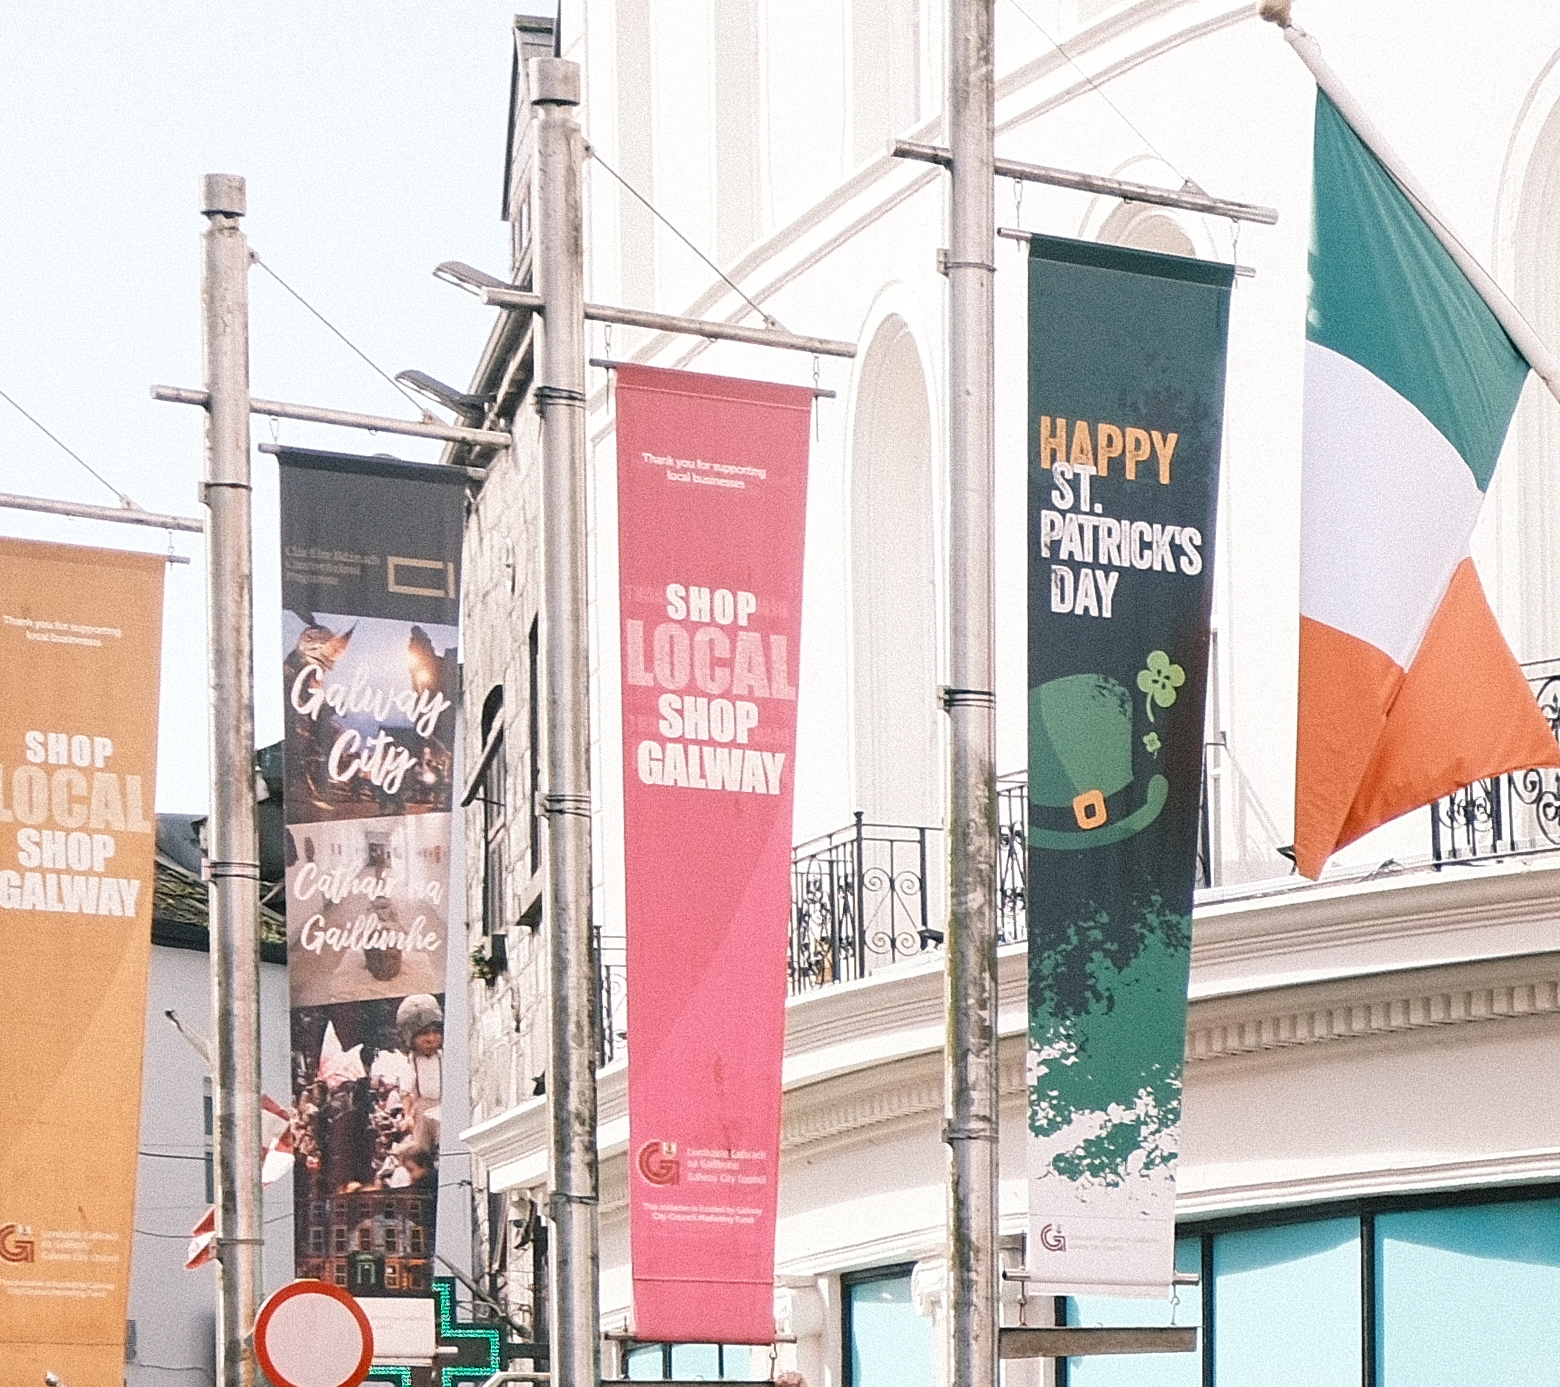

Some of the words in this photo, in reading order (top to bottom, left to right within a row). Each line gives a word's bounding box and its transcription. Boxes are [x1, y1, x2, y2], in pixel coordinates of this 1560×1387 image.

[1040, 415, 1178, 485] HAPPY
[1051, 461, 1103, 514] ST.
[1041, 509, 1203, 576] PATRICK'S
[666, 583, 757, 627] SHOP
[1051, 564, 1120, 619] DAY
[626, 618, 796, 700] LOCAL
[291, 664, 452, 737] Galway
[658, 693, 759, 744] SHOP
[25, 730, 114, 768] SHOP
[328, 728, 418, 794] City
[637, 740, 786, 795] GALWAY
[17, 827, 116, 872] SHOP
[0, 869, 141, 918] GALWAY
[301, 912, 442, 955] Gaillimhe
